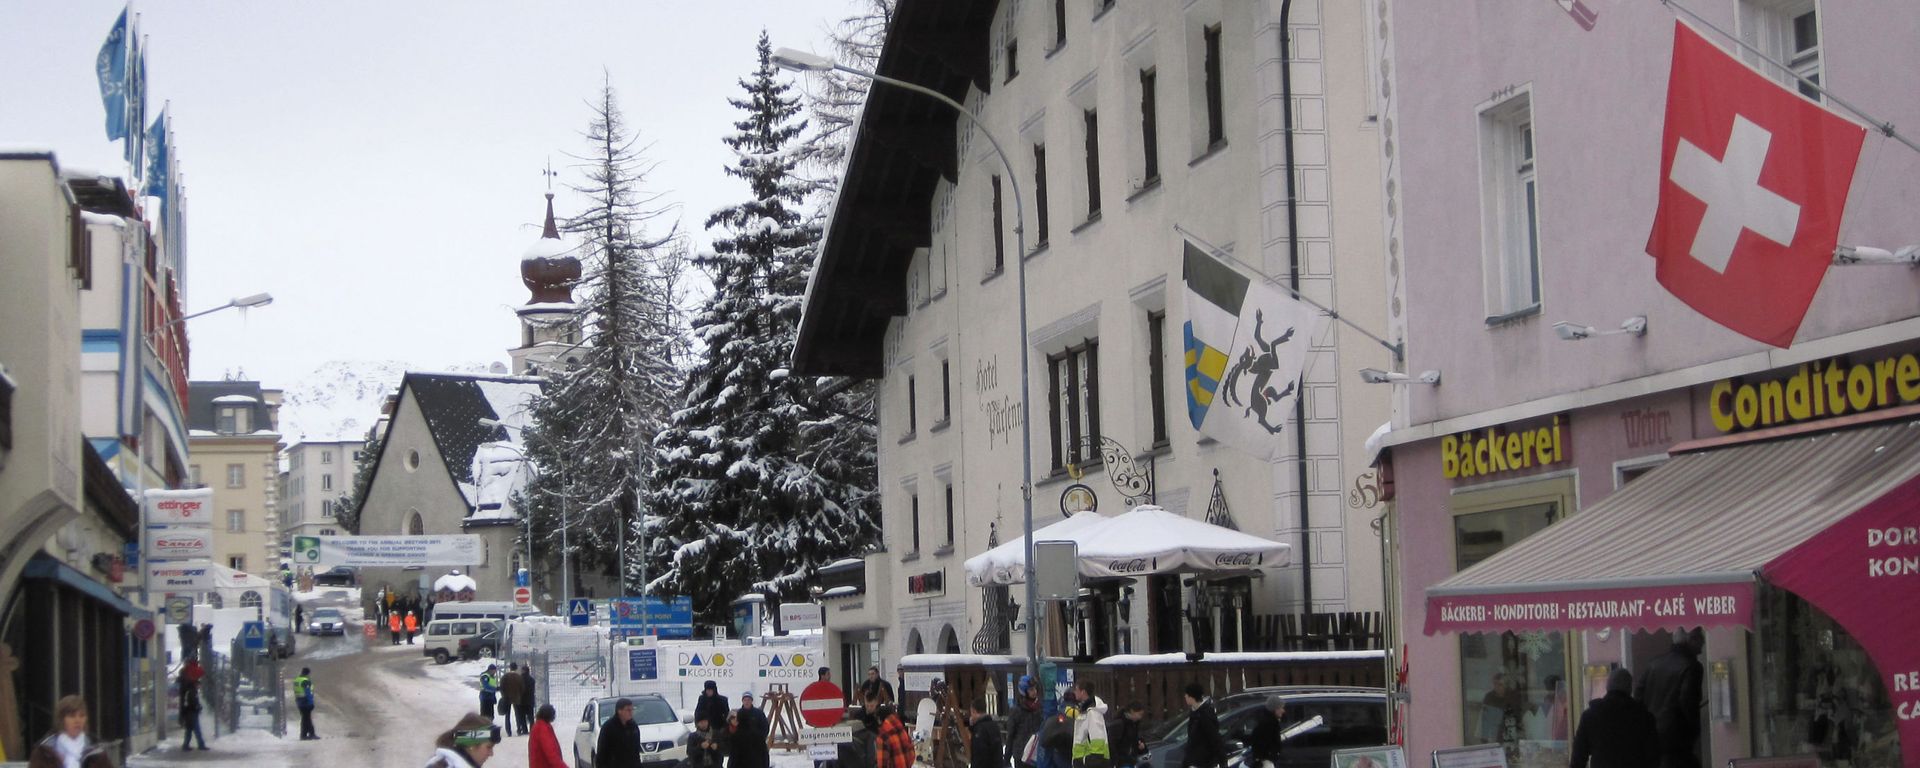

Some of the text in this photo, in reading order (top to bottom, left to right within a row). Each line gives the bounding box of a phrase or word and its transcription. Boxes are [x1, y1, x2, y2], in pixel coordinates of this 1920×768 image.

[976, 354, 998, 395] Hotel
[1621, 406, 1672, 448] Weber
[1441, 415, 1563, 478] Bäckerei
[157, 501, 202, 517] ettinger
[157, 539, 203, 548] Ranch
[1868, 527, 1920, 547] DOR
[1441, 593, 1736, 622] BÄCKEREI KONDITOREI RESTAURANT CAFÉ WEBER
[678, 652, 734, 667] DAVOS
[758, 653, 814, 668] DAVOS
[688, 668, 733, 678] KLOSTERS
[767, 669, 813, 679] KLOSTERS
